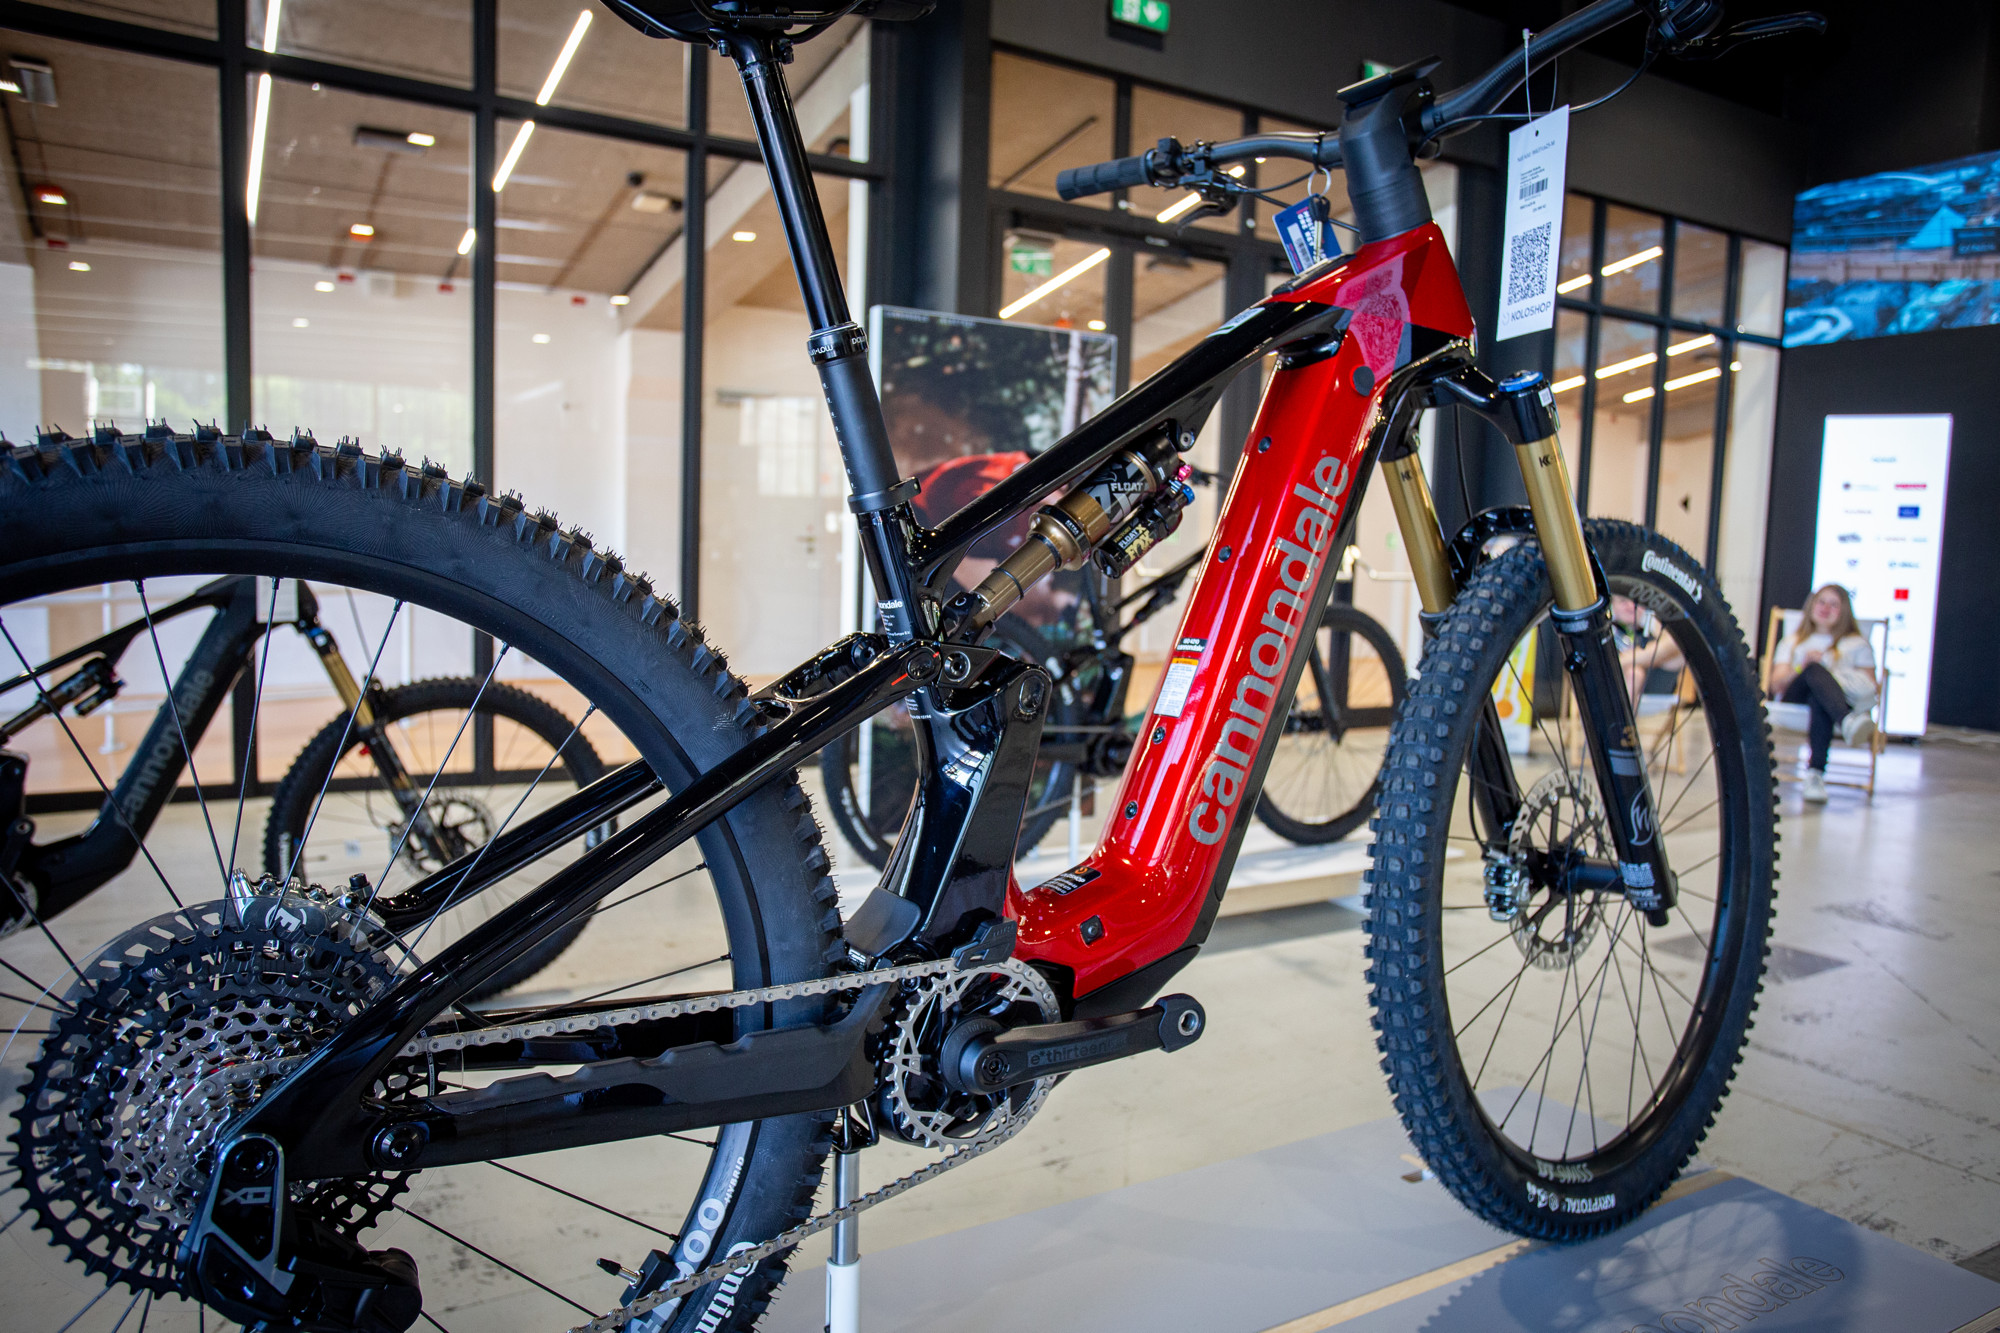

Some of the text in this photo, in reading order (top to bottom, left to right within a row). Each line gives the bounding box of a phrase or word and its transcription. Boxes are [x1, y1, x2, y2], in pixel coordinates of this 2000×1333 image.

[1511, 301, 1552, 322] KOLOSHOP
[1110, 482, 1143, 492] FLOAT
[1117, 530, 1140, 549] FLOAT
[1125, 530, 1154, 561] FOX
[1641, 550, 1698, 596] Continental
[1188, 455, 1350, 846] cannondale
[724, 1156, 745, 1204] HYBRID
[1565, 1193, 1616, 1214] KRYPTOTAL
[1622, 1256, 1845, 1333] ondale
